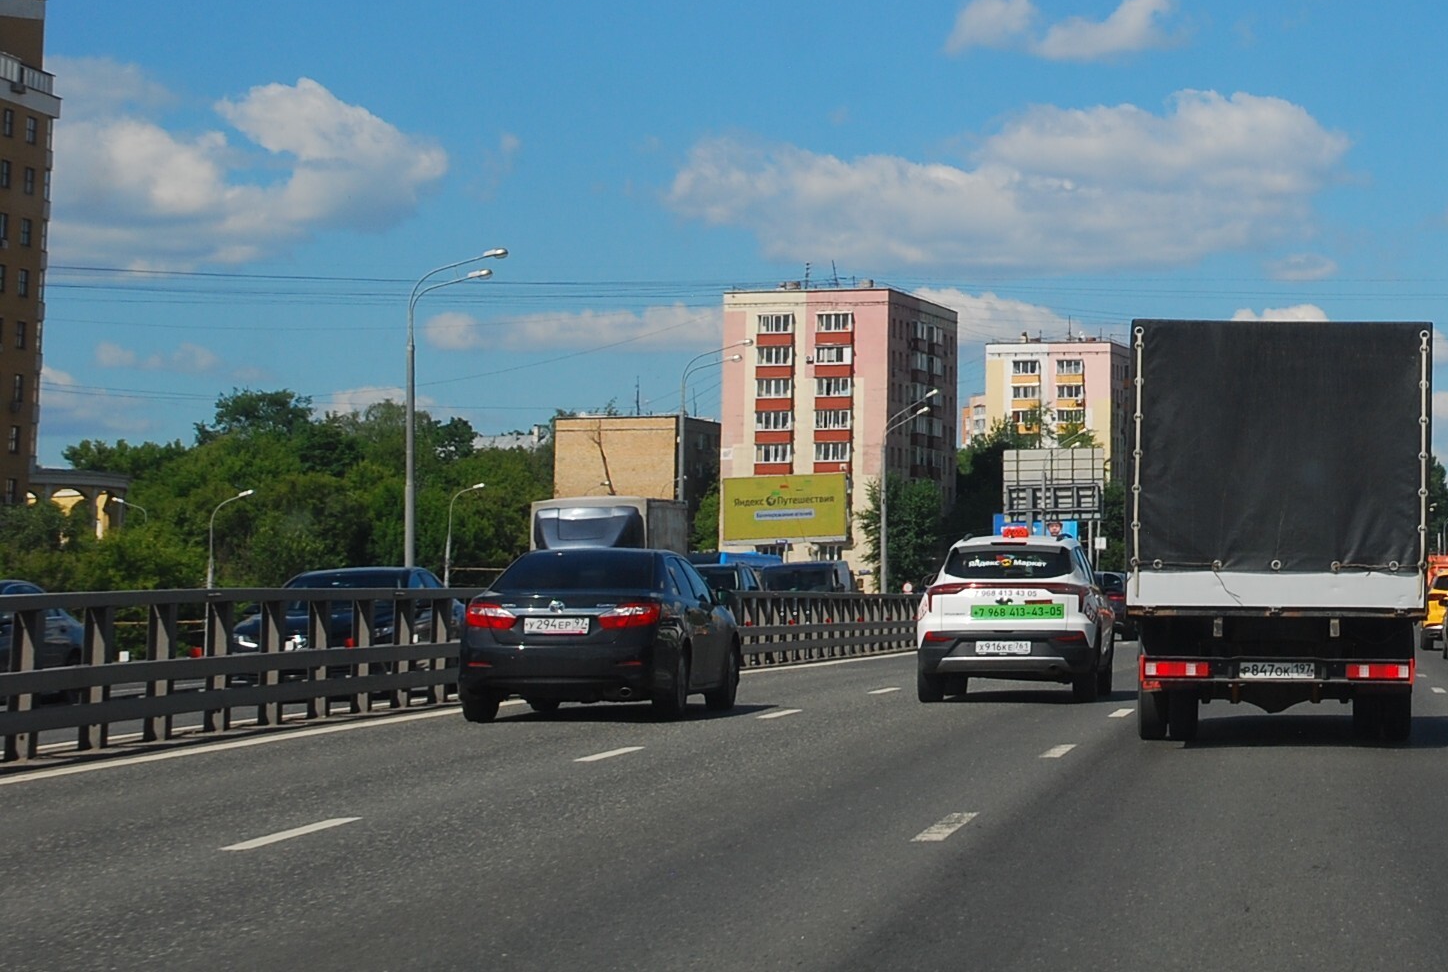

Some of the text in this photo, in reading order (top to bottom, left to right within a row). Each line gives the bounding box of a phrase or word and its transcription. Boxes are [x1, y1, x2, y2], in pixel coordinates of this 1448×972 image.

[733, 495, 835, 507] Яндекс Путешествия
[1013, 559, 1047, 567] Маркет
[973, 608, 985, 617] +7
[988, 608, 1006, 617] 968
[1009, 606, 1062, 616] 413-43-05
